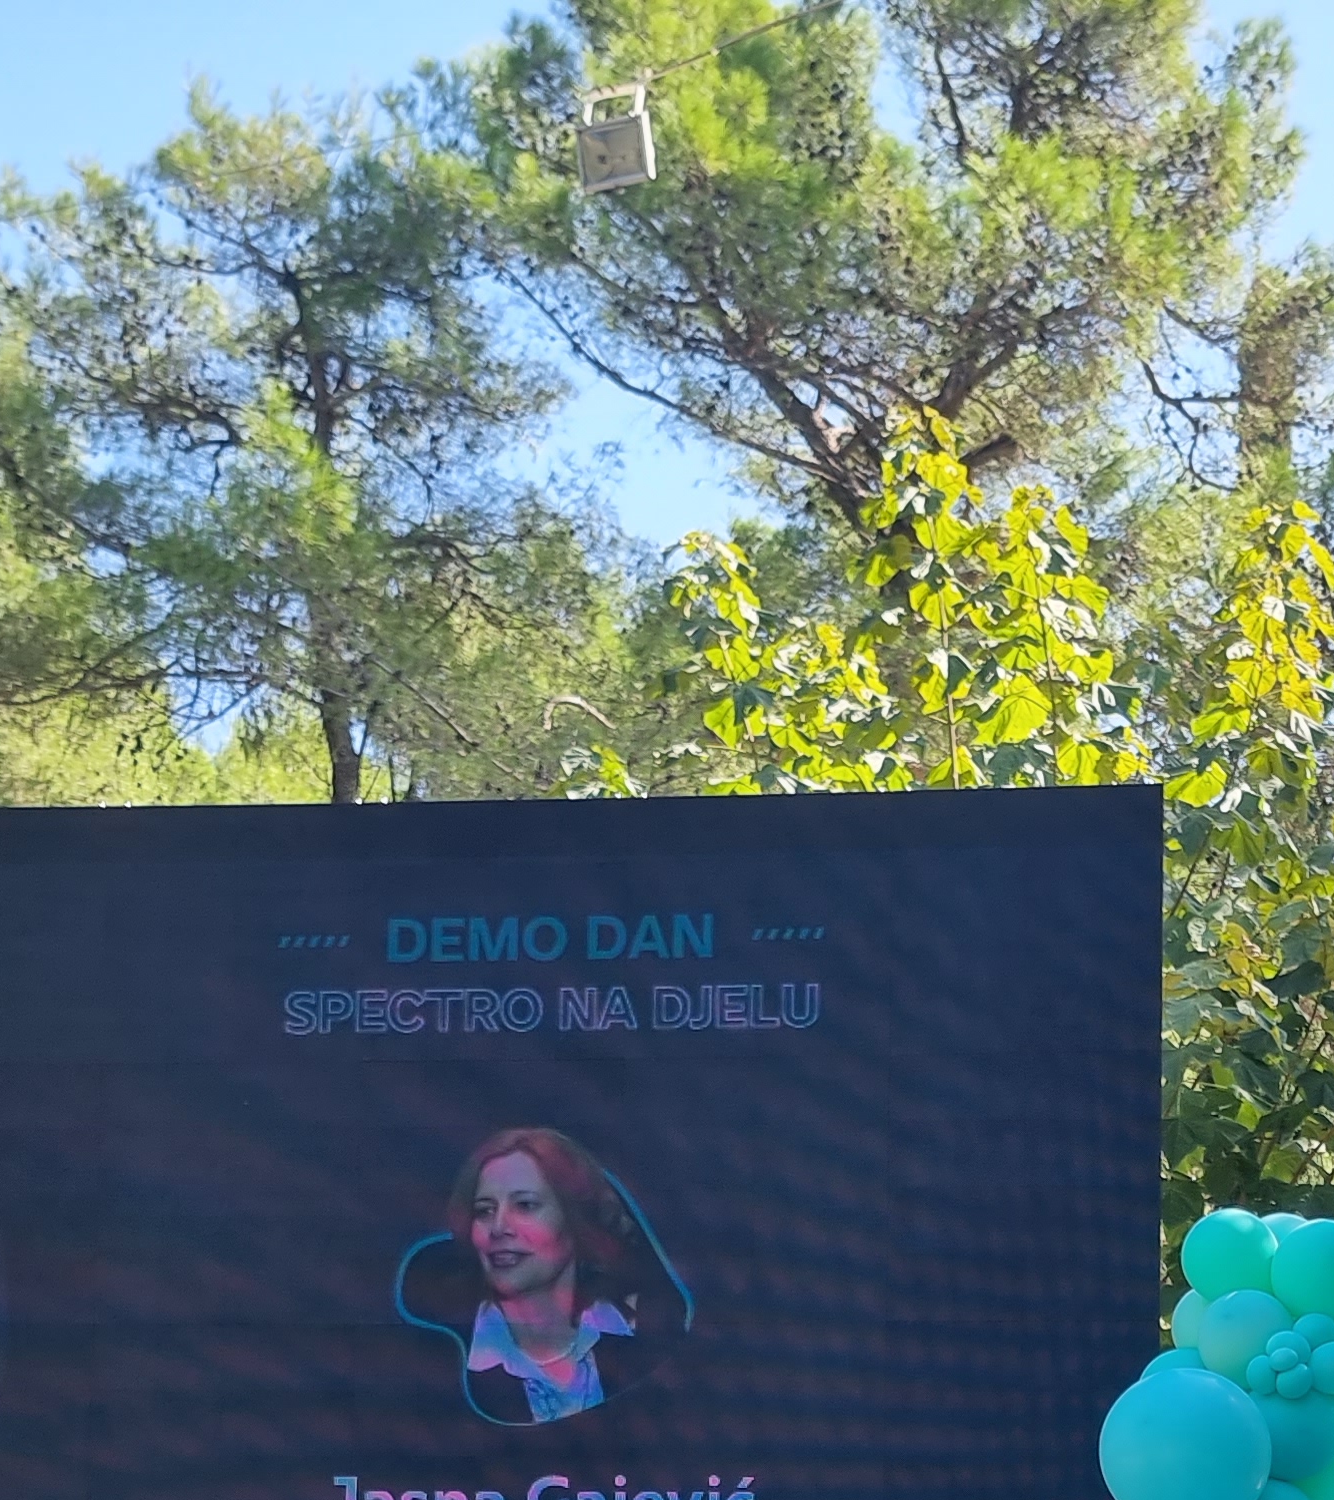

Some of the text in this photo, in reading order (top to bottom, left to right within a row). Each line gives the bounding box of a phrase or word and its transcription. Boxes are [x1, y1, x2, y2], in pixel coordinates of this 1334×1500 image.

[386, 914, 714, 963] DEMO DAN
[284, 983, 821, 1036] SPECTRO NA DJELU
